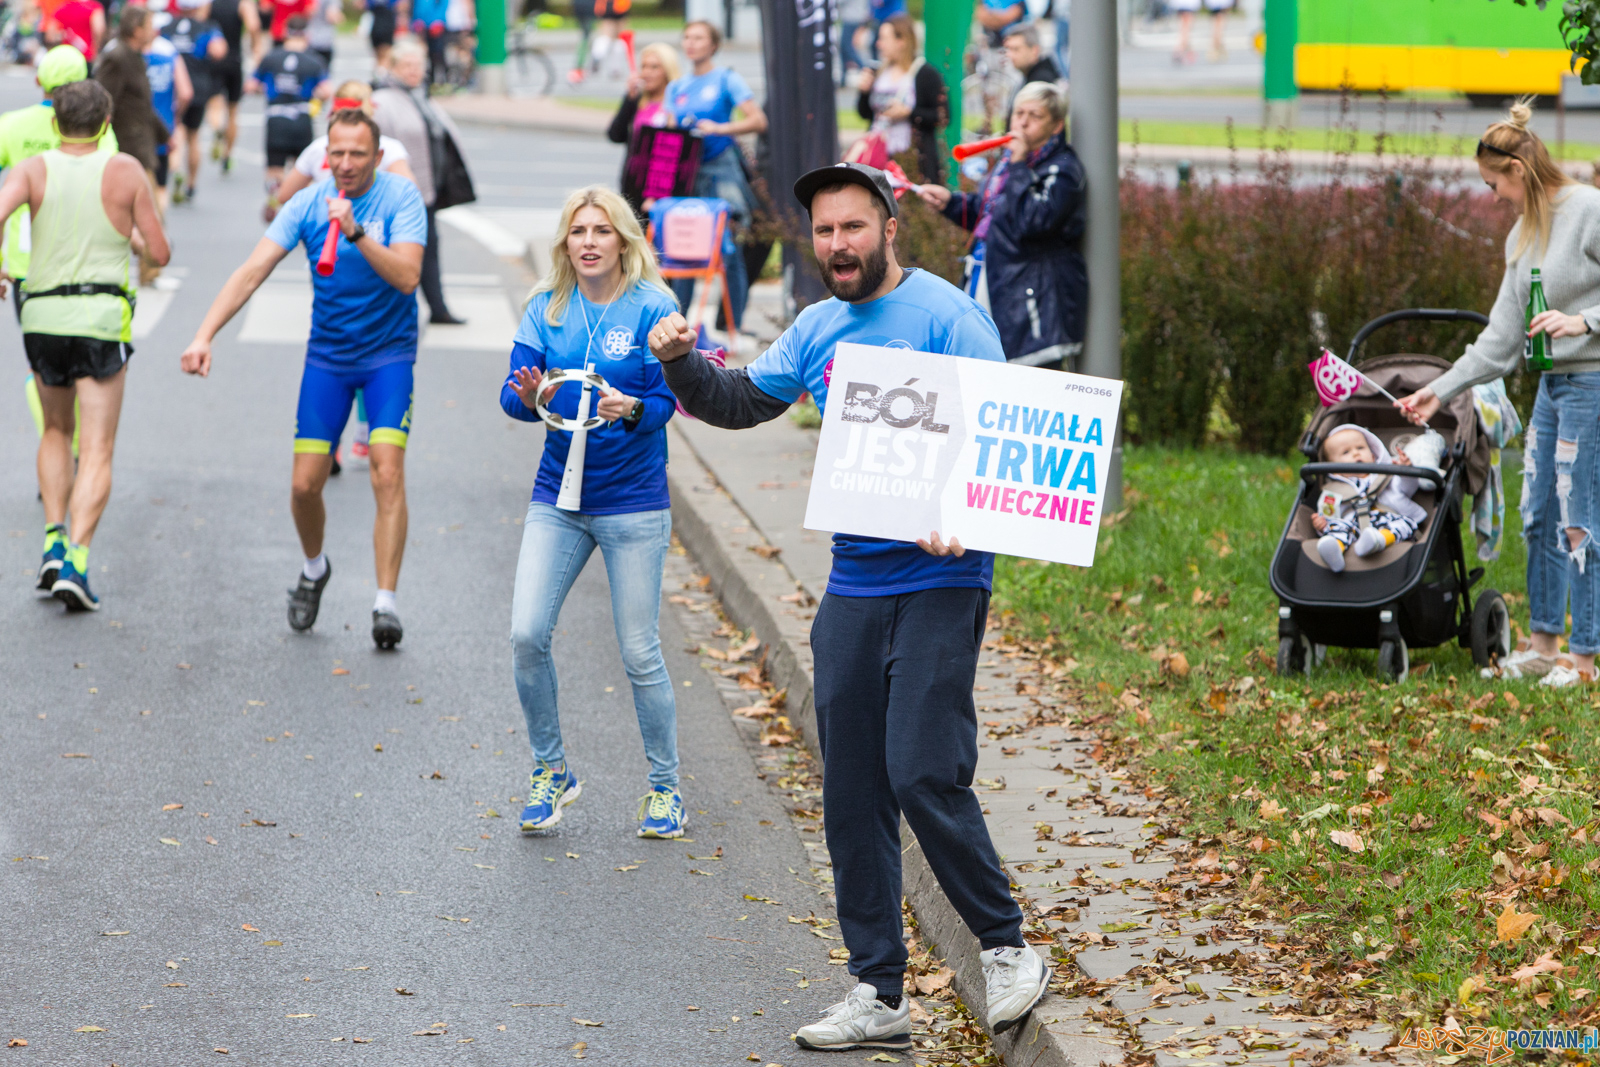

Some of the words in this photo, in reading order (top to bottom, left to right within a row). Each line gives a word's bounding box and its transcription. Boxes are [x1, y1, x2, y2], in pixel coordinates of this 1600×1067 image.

[841, 377, 950, 434] BÓL
[1064, 383, 1113, 398] #PRO366
[978, 400, 1103, 447] CHWAŁA
[832, 424, 948, 480] JEST
[974, 434, 1097, 495] TRWA
[829, 470, 936, 501] CHWILOWY
[966, 481, 1096, 526] WIECZNIE
